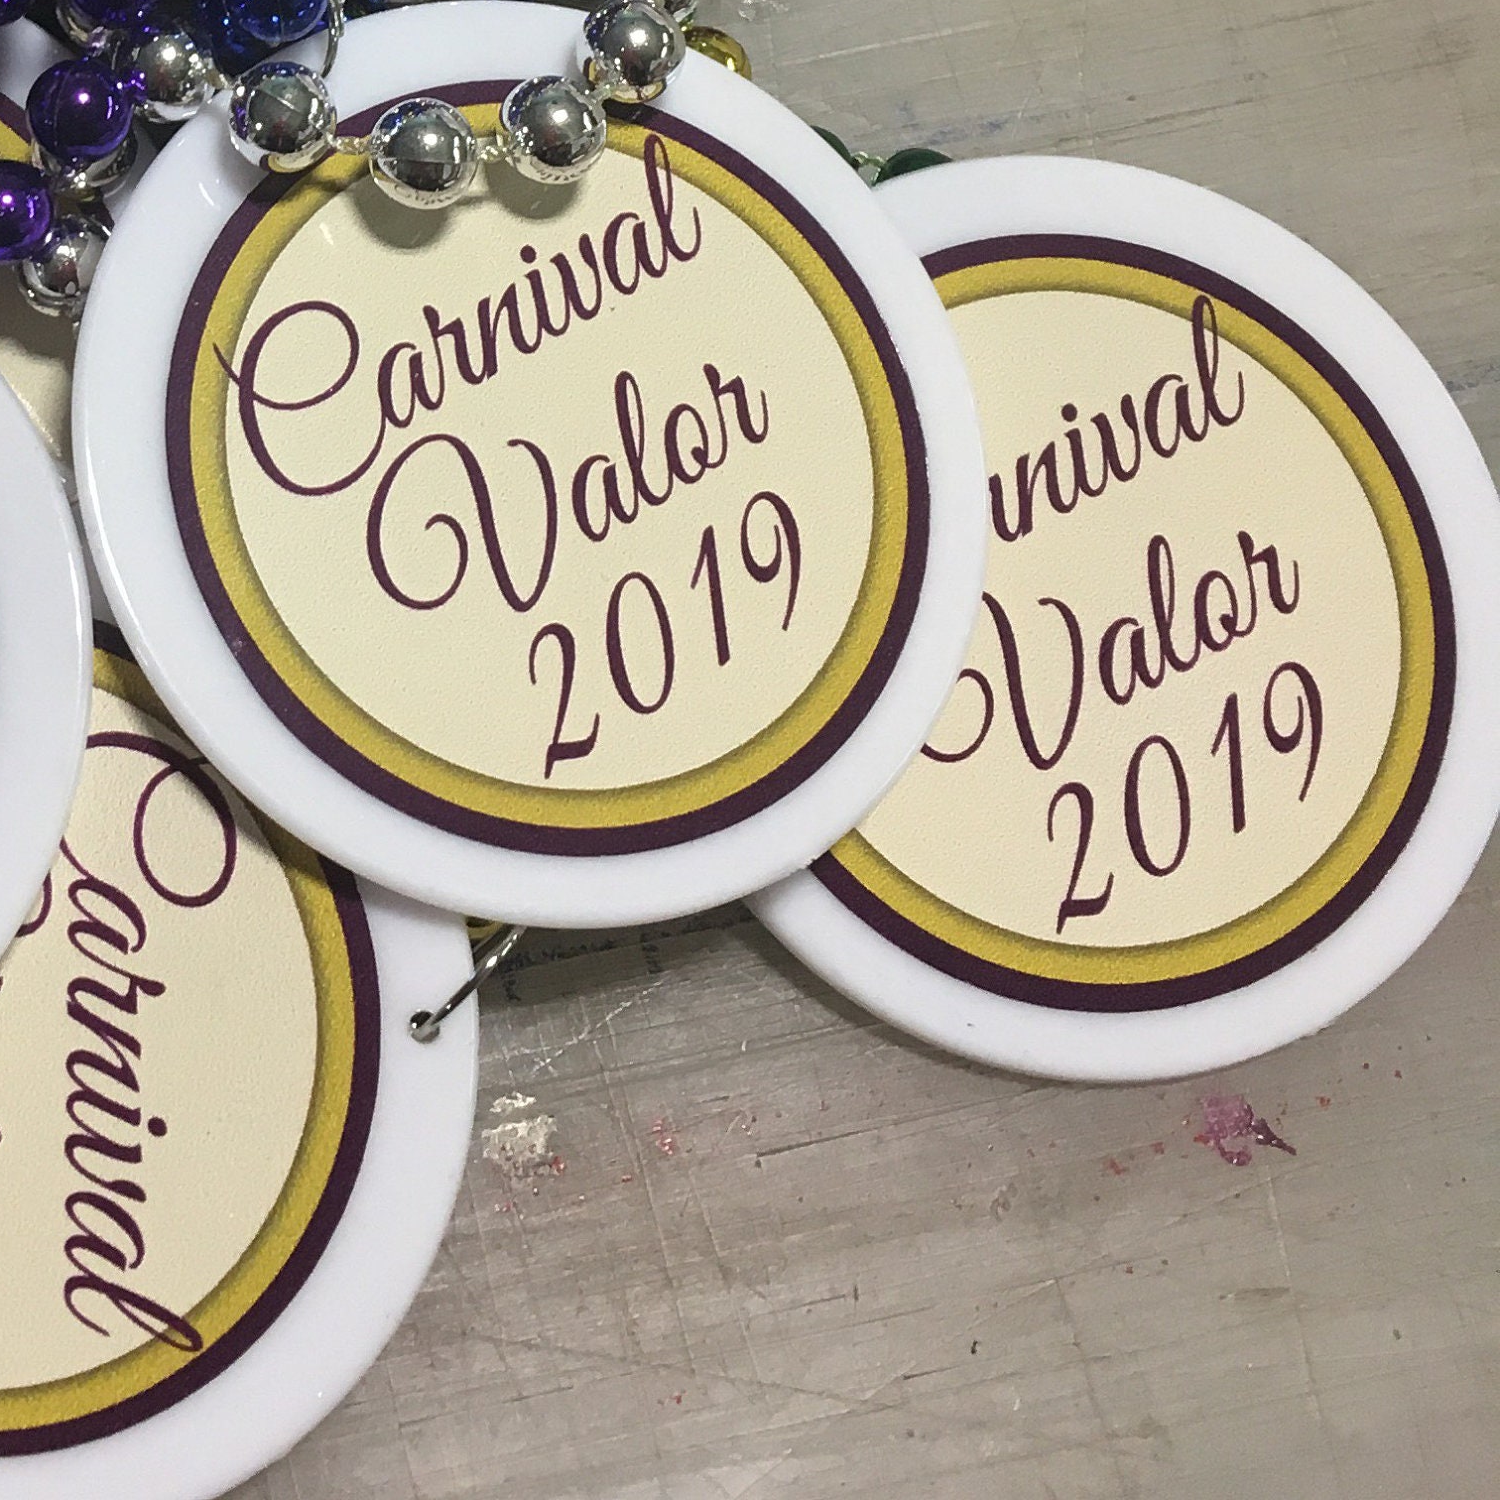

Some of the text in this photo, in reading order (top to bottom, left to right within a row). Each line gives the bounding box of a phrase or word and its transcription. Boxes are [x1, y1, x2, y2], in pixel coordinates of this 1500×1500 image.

[212, 133, 701, 496] Carnival
[367, 364, 768, 612] Valor
[528, 491, 800, 779] 2019
[920, 531, 1299, 770] Valor
[1048, 661, 1323, 934] 2019
